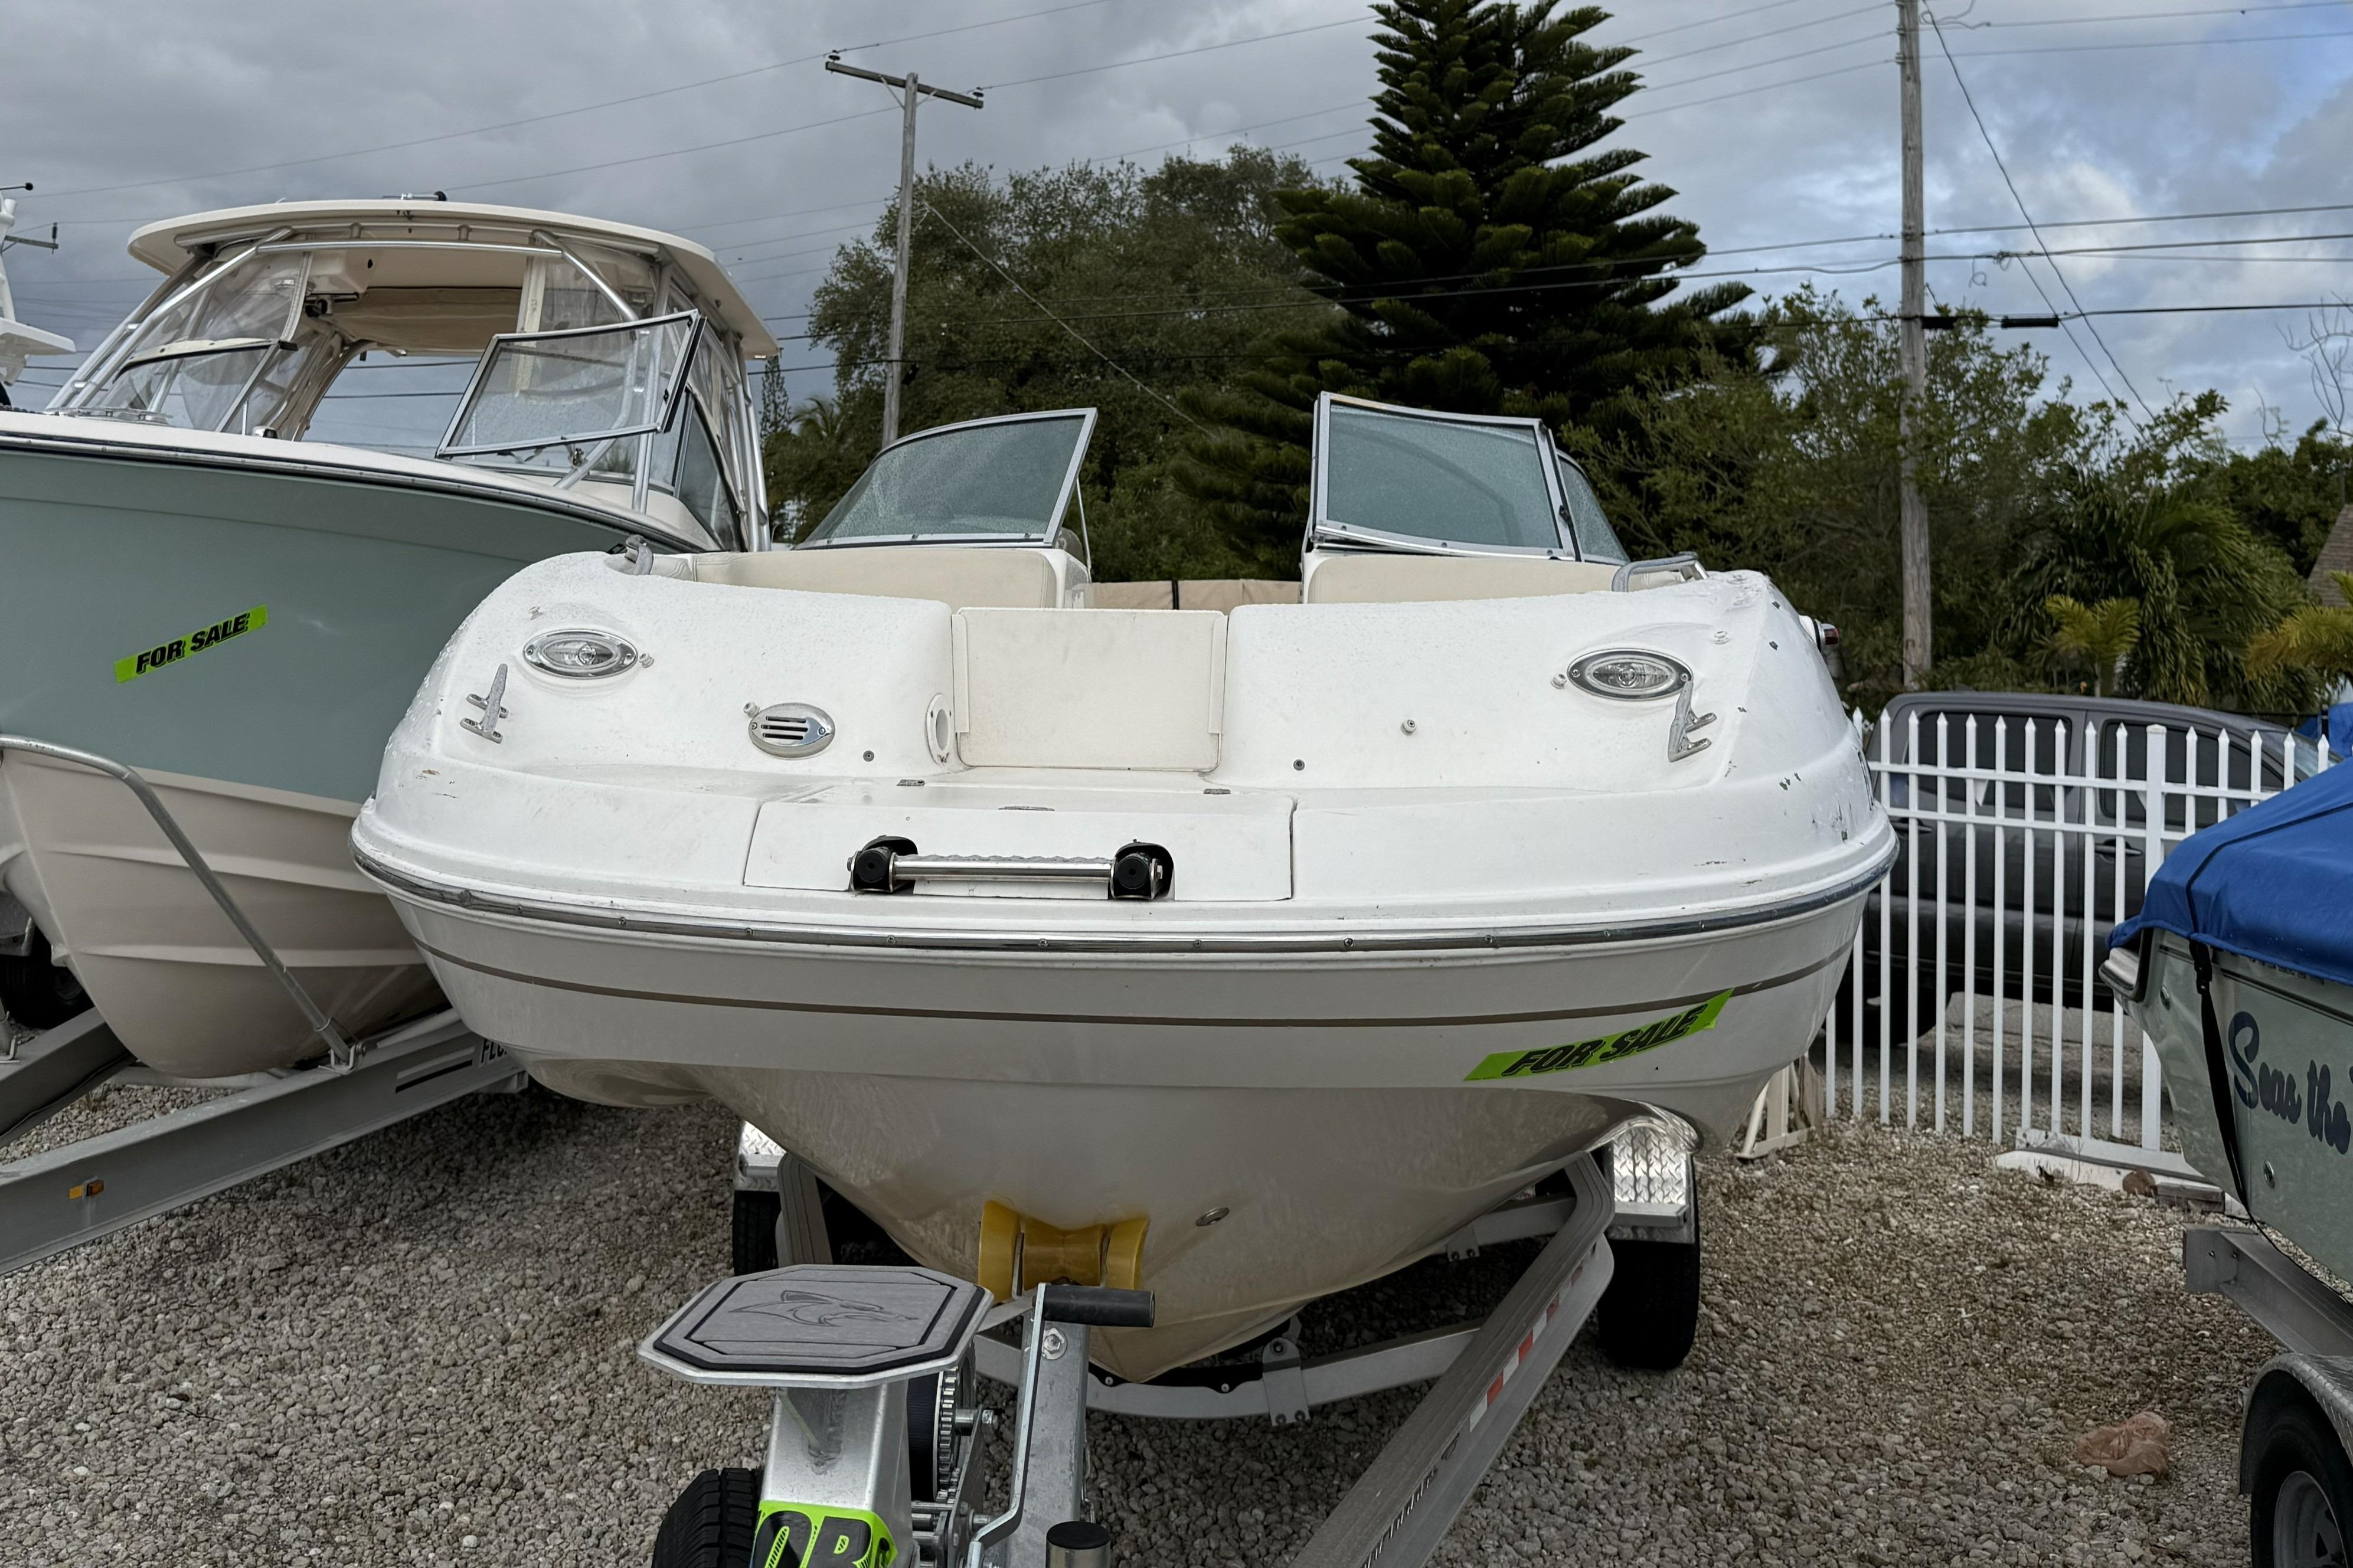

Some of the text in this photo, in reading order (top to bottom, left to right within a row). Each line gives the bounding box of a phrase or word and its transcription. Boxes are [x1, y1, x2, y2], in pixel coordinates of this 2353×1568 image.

[136, 613, 250, 675] FOR SALE
[1501, 1003, 1708, 1076] FOR SALE
